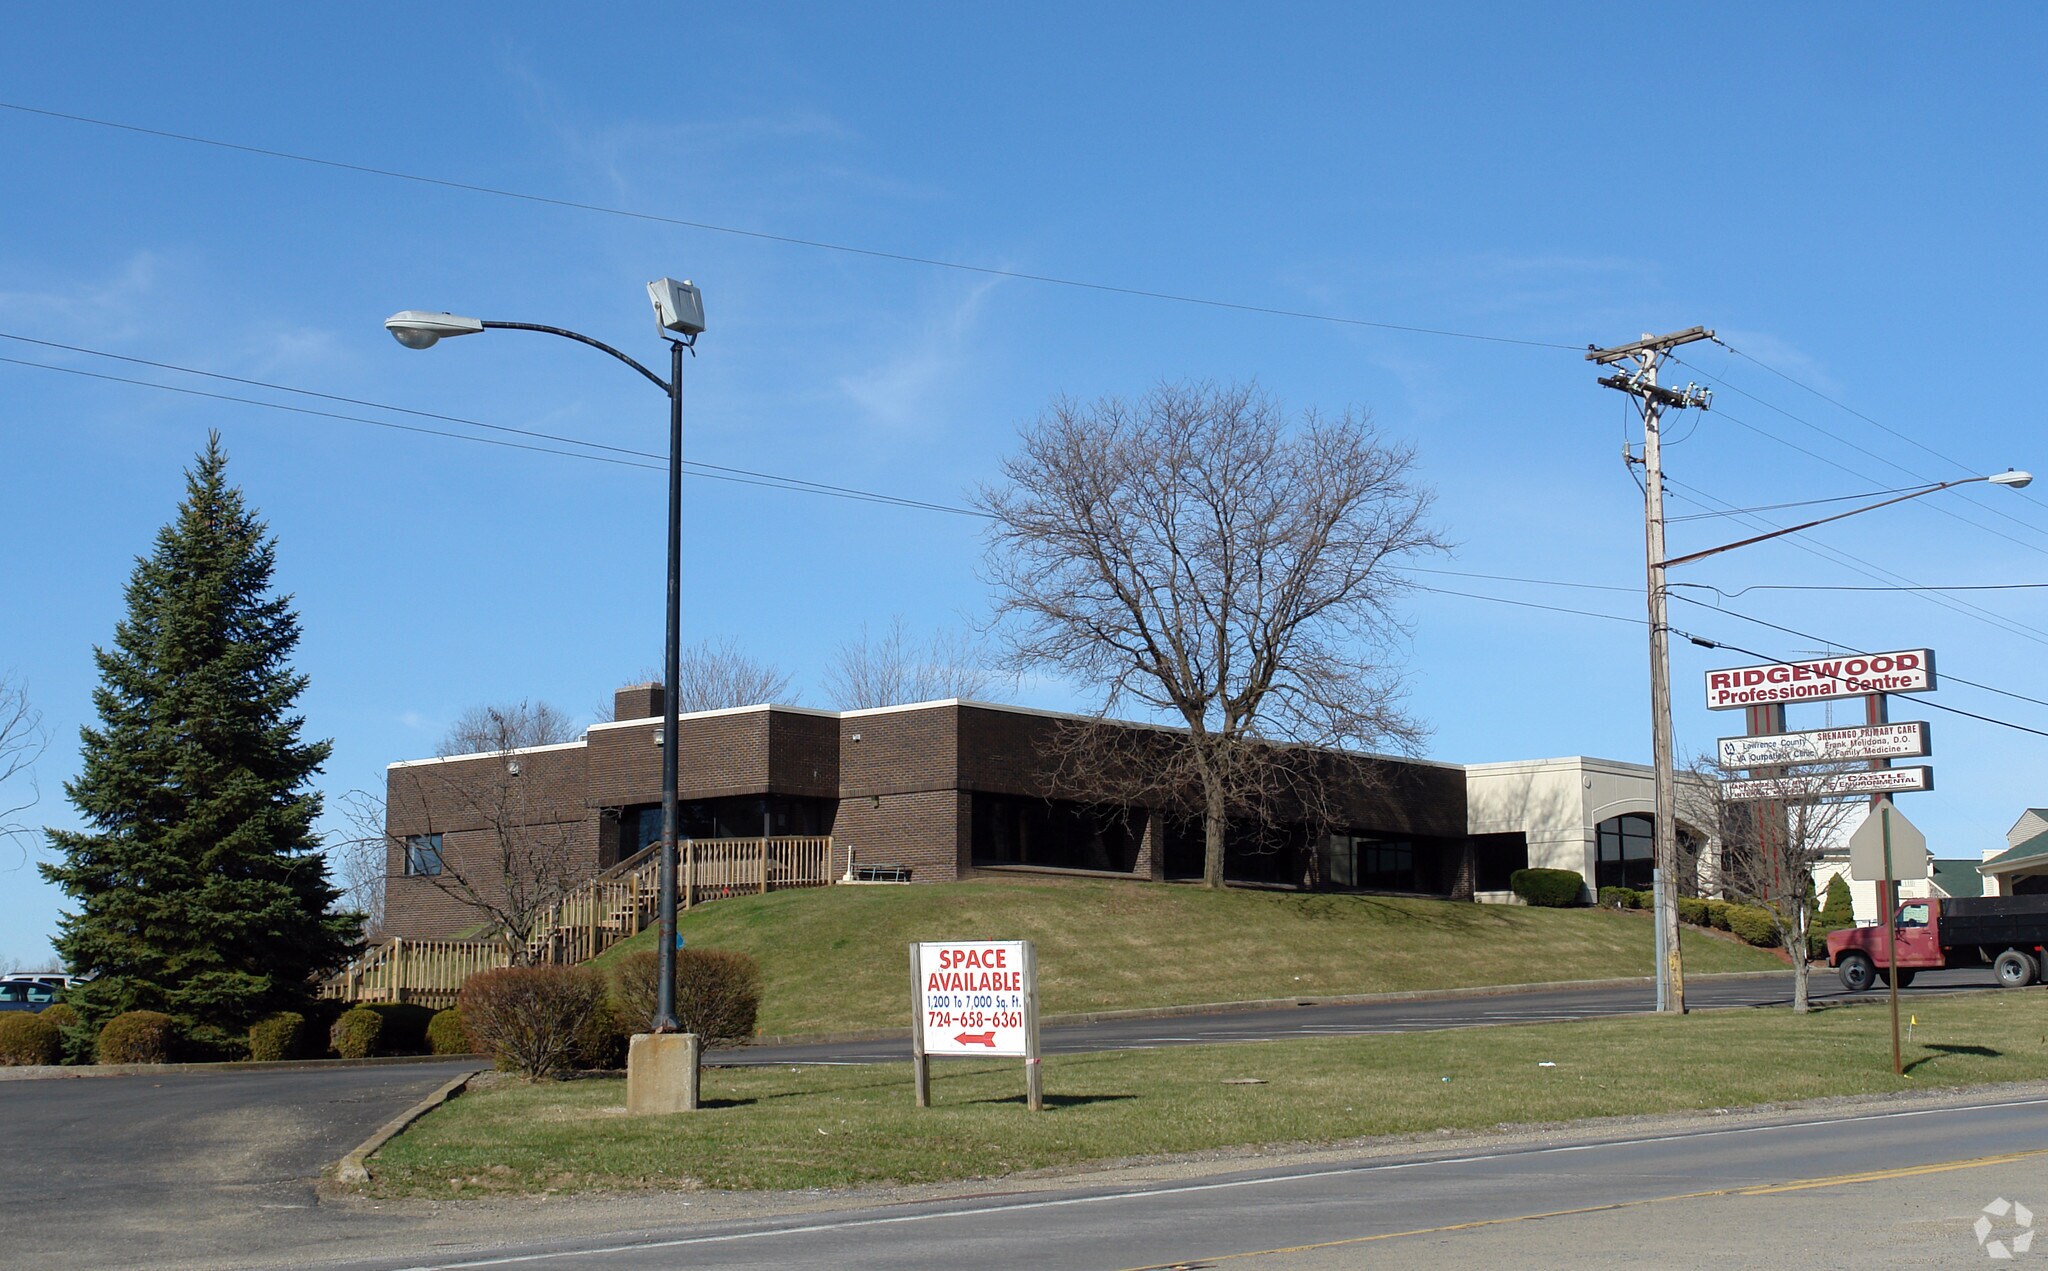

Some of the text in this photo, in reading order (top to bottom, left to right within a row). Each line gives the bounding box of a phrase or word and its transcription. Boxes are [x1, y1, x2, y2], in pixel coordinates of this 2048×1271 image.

[1711, 654, 1919, 689] RIDGEWOOD
[1718, 676, 1912, 704] Professional Centre
[1817, 725, 1917, 741] SHENANGO PRIMARY CARE
[1893, 735, 1911, 744] D.O.
[1743, 738, 1806, 750] Lawrence County
[1835, 746, 1901, 757] Family Medicine
[1793, 749, 1815, 758] Clinic
[1847, 772, 1906, 782] CASTLE
[939, 949, 1006, 969] SPACE
[928, 972, 1021, 991] AVAILABLE
[928, 995, 1021, 1012] 1,200 To 7,000 Sq. Ft.
[928, 1011, 1022, 1028] 724-658-6361
